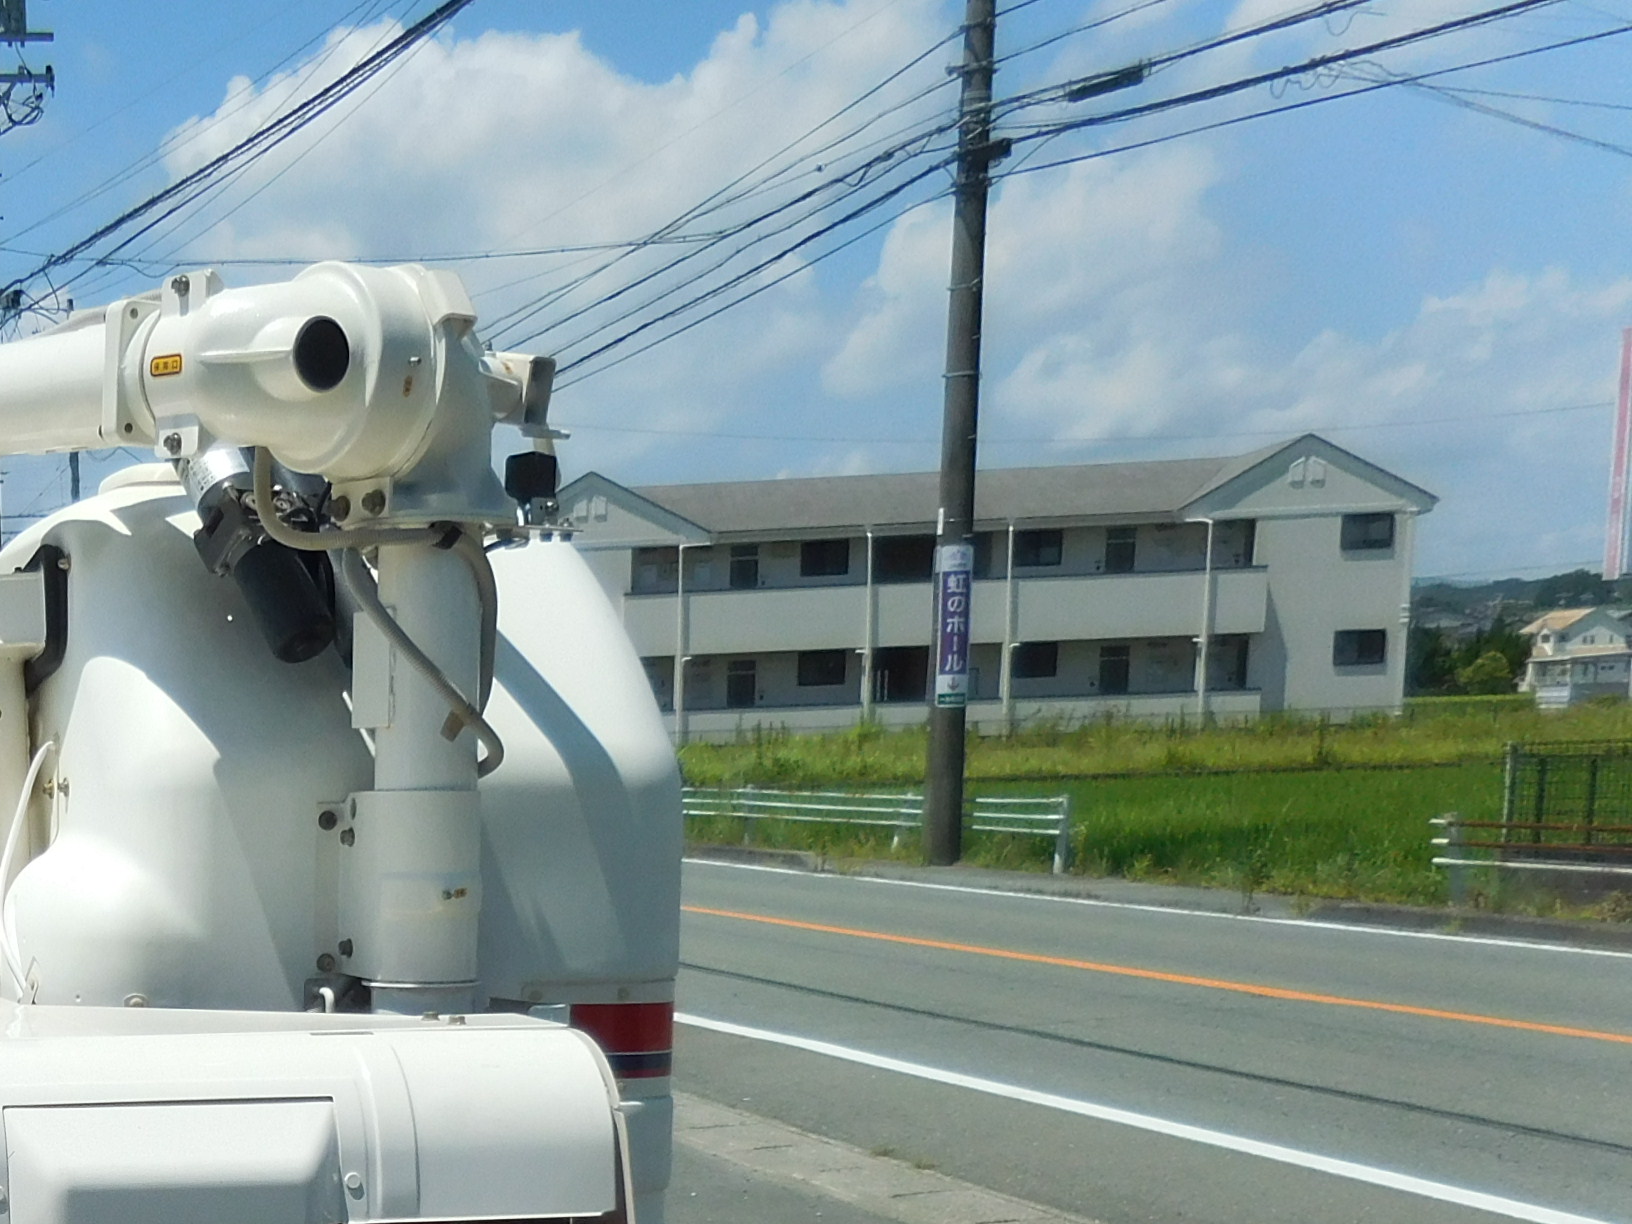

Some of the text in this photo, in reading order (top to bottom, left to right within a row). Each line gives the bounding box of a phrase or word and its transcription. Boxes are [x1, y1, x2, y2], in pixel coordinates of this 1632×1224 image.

[945, 574, 966, 671] 虹のホール
